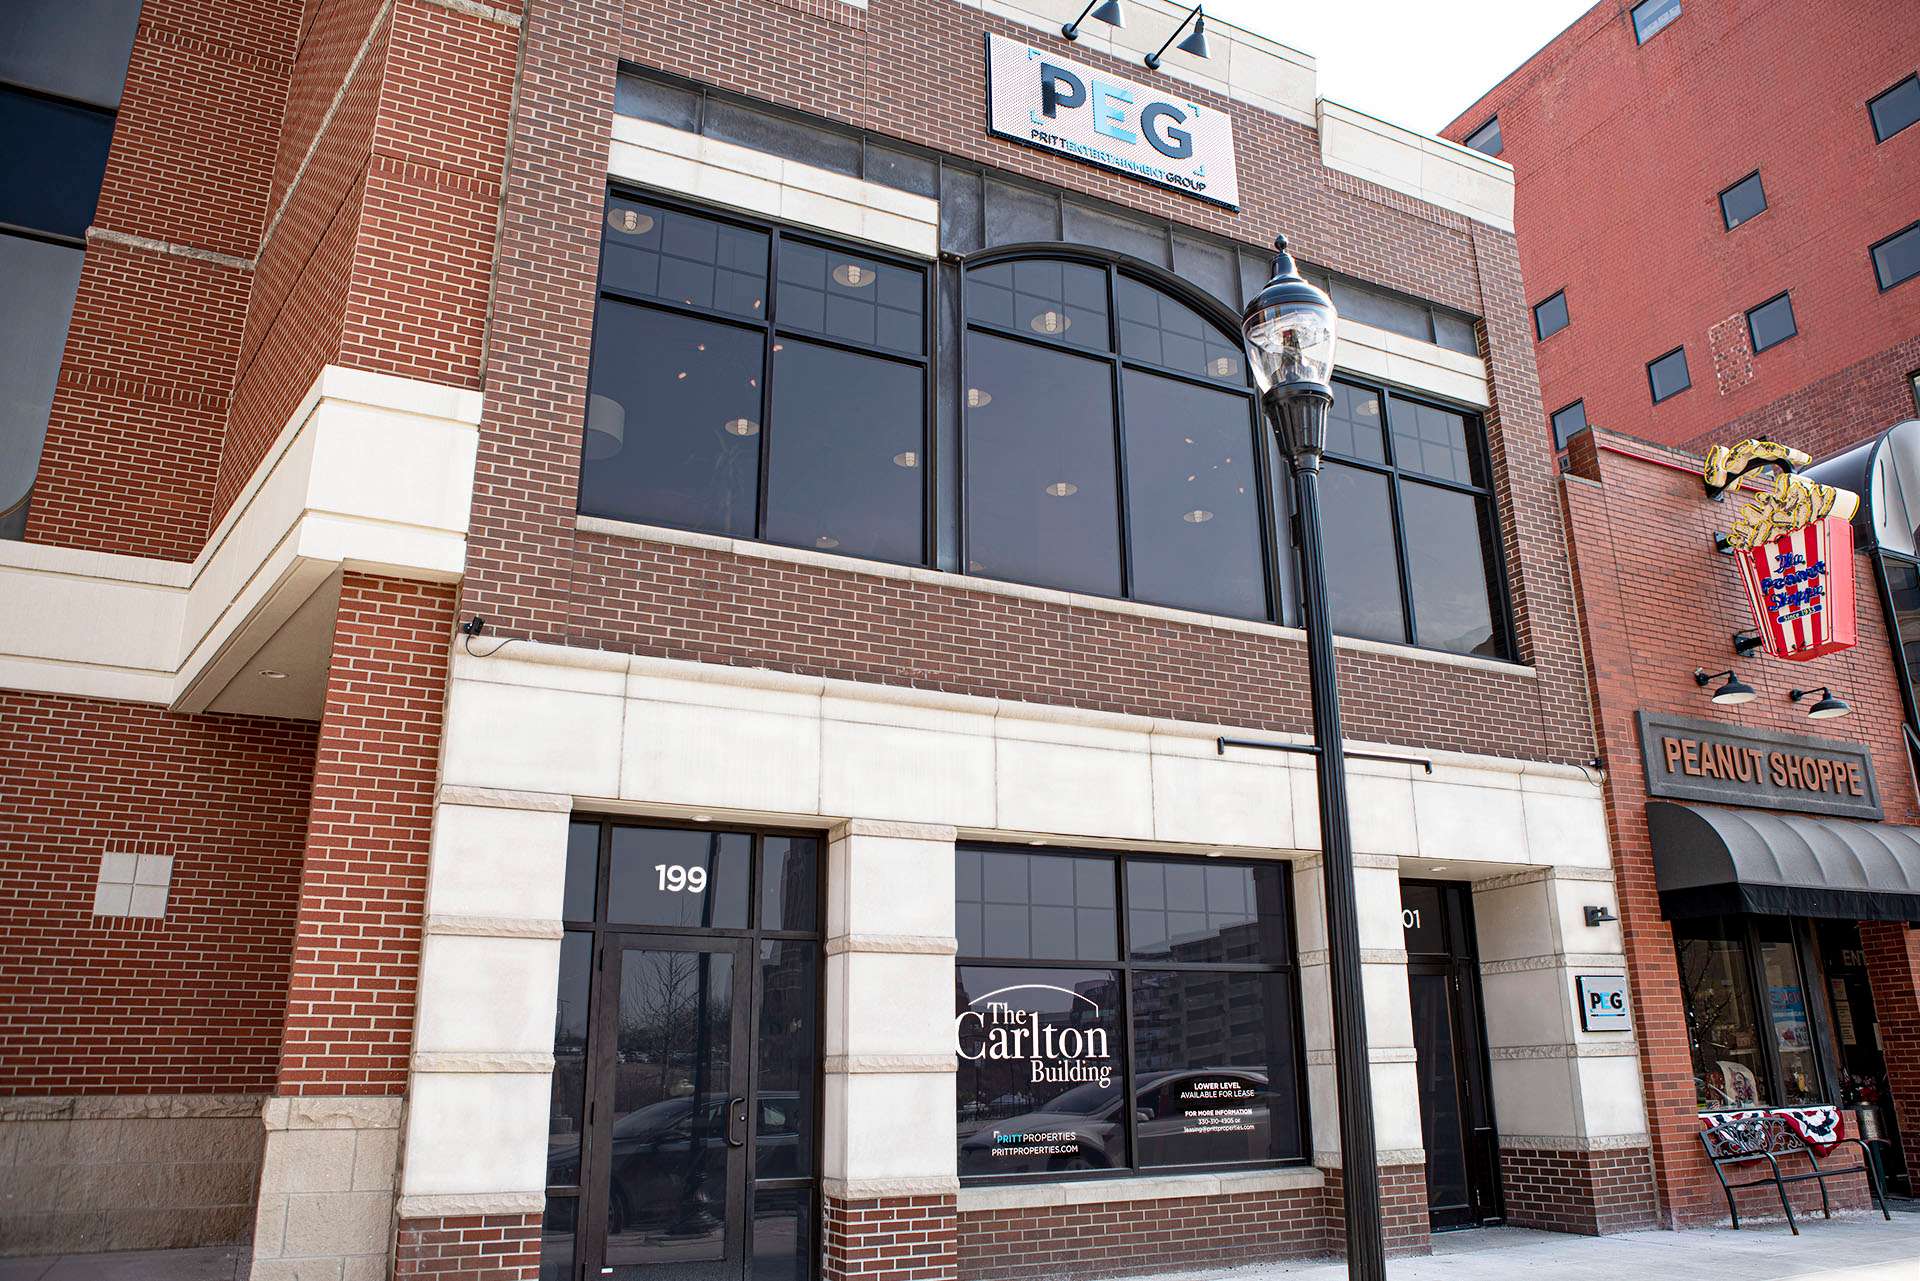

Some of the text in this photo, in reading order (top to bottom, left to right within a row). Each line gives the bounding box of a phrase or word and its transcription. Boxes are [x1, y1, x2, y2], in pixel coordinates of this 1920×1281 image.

[1040, 61, 1193, 159] PEG
[1662, 737, 1865, 796] PEANUT SHOPPE
[655, 864, 707, 893] 199
[1590, 992, 1623, 1009] PEG
[987, 1002, 1027, 1025] The
[955, 1011, 1110, 1060] Carlton
[1030, 1060, 1112, 1088] Building
[1180, 1089, 1255, 1099] AVAILABLE FOR LEASE
[1194, 1082, 1241, 1090] LOWER LEVEL
[1198, 1109, 1214, 1117] MORE
[1214, 1108, 1253, 1116] INFORMATION
[991, 1145, 1079, 1156] PRITTPROPERTIES.COM
